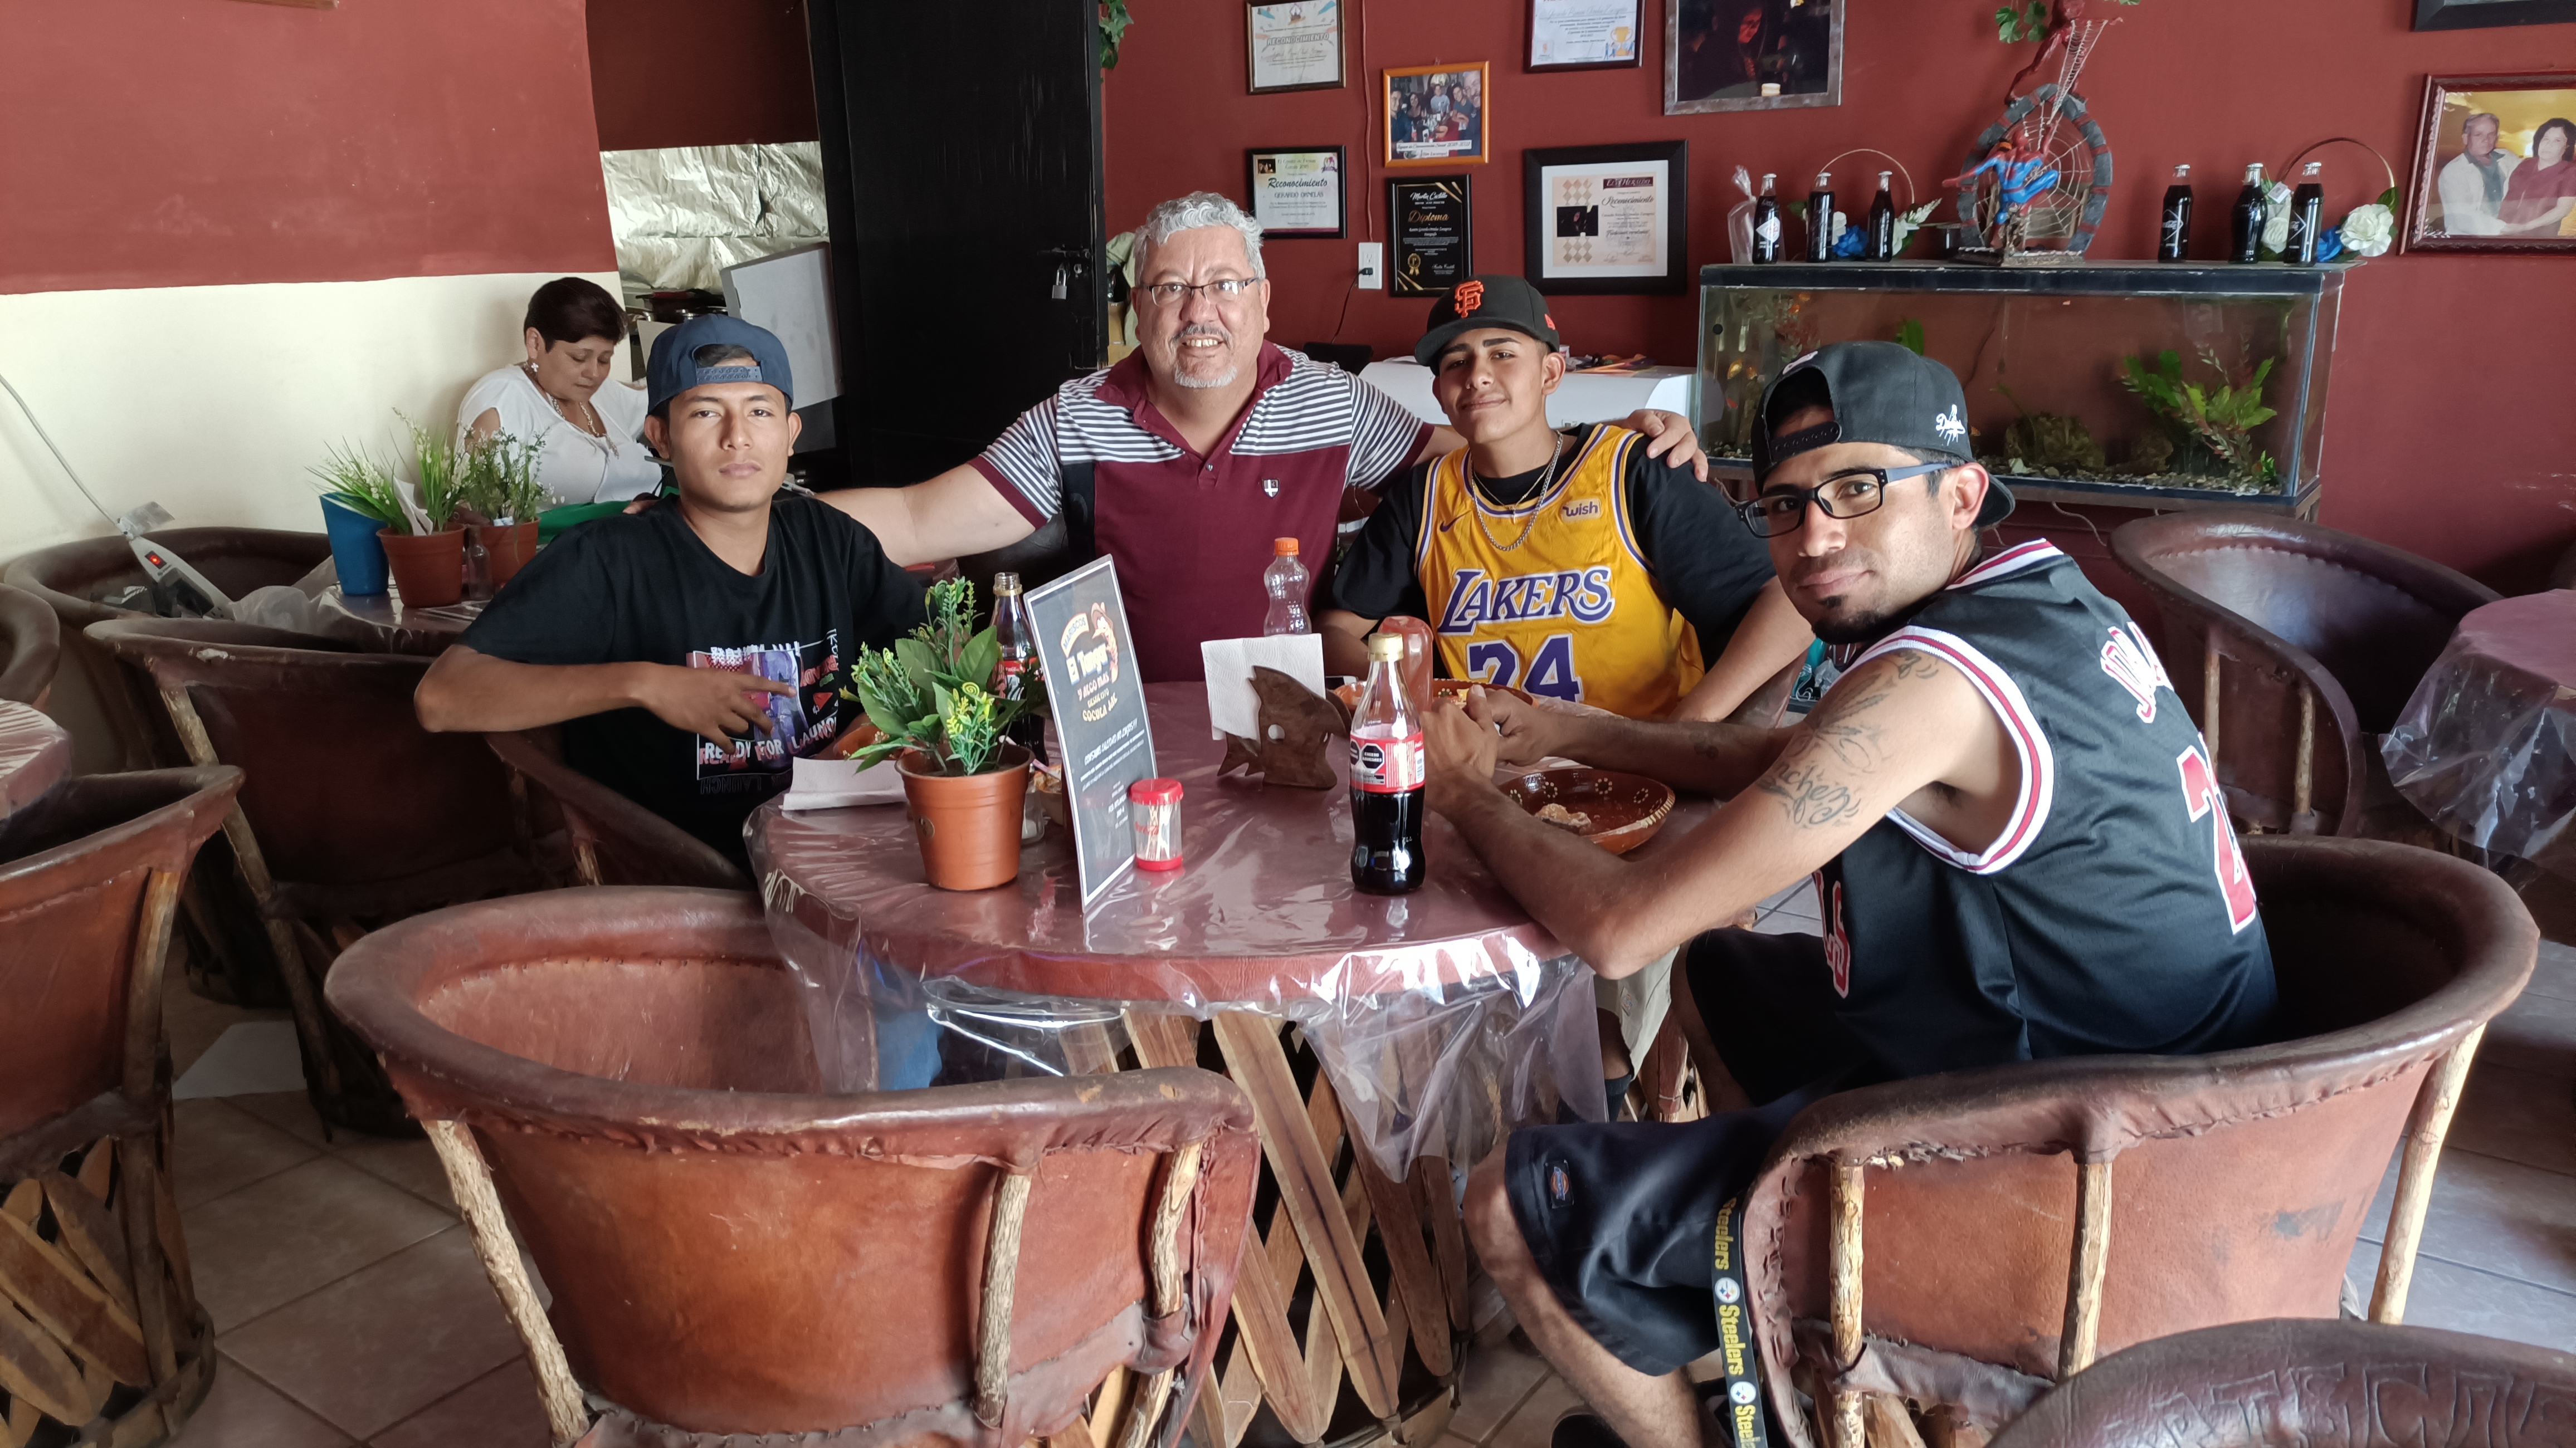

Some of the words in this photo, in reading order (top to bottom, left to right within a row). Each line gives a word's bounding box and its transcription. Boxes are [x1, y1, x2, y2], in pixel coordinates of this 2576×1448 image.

[1267, 33, 1329, 46] RECONOCIMIENTO
[1267, 177, 1328, 189] Reconocimiento
[1408, 210, 1449, 224] Diploma
[1602, 195, 1655, 208] Reconocimiento
[1455, 280, 1484, 319] SF
[1562, 501, 1598, 517] wish
[1437, 565, 1616, 635] LAKERS
[1063, 617, 1086, 650] MARISCOS
[1466, 633, 1584, 703] 24
[705, 741, 751, 759] REDY
[757, 738, 784, 755] FOR
[2177, 732, 2256, 935] 2
[1715, 1197, 1737, 1270] Steelers
[1719, 1304, 1746, 1376] Steelers
